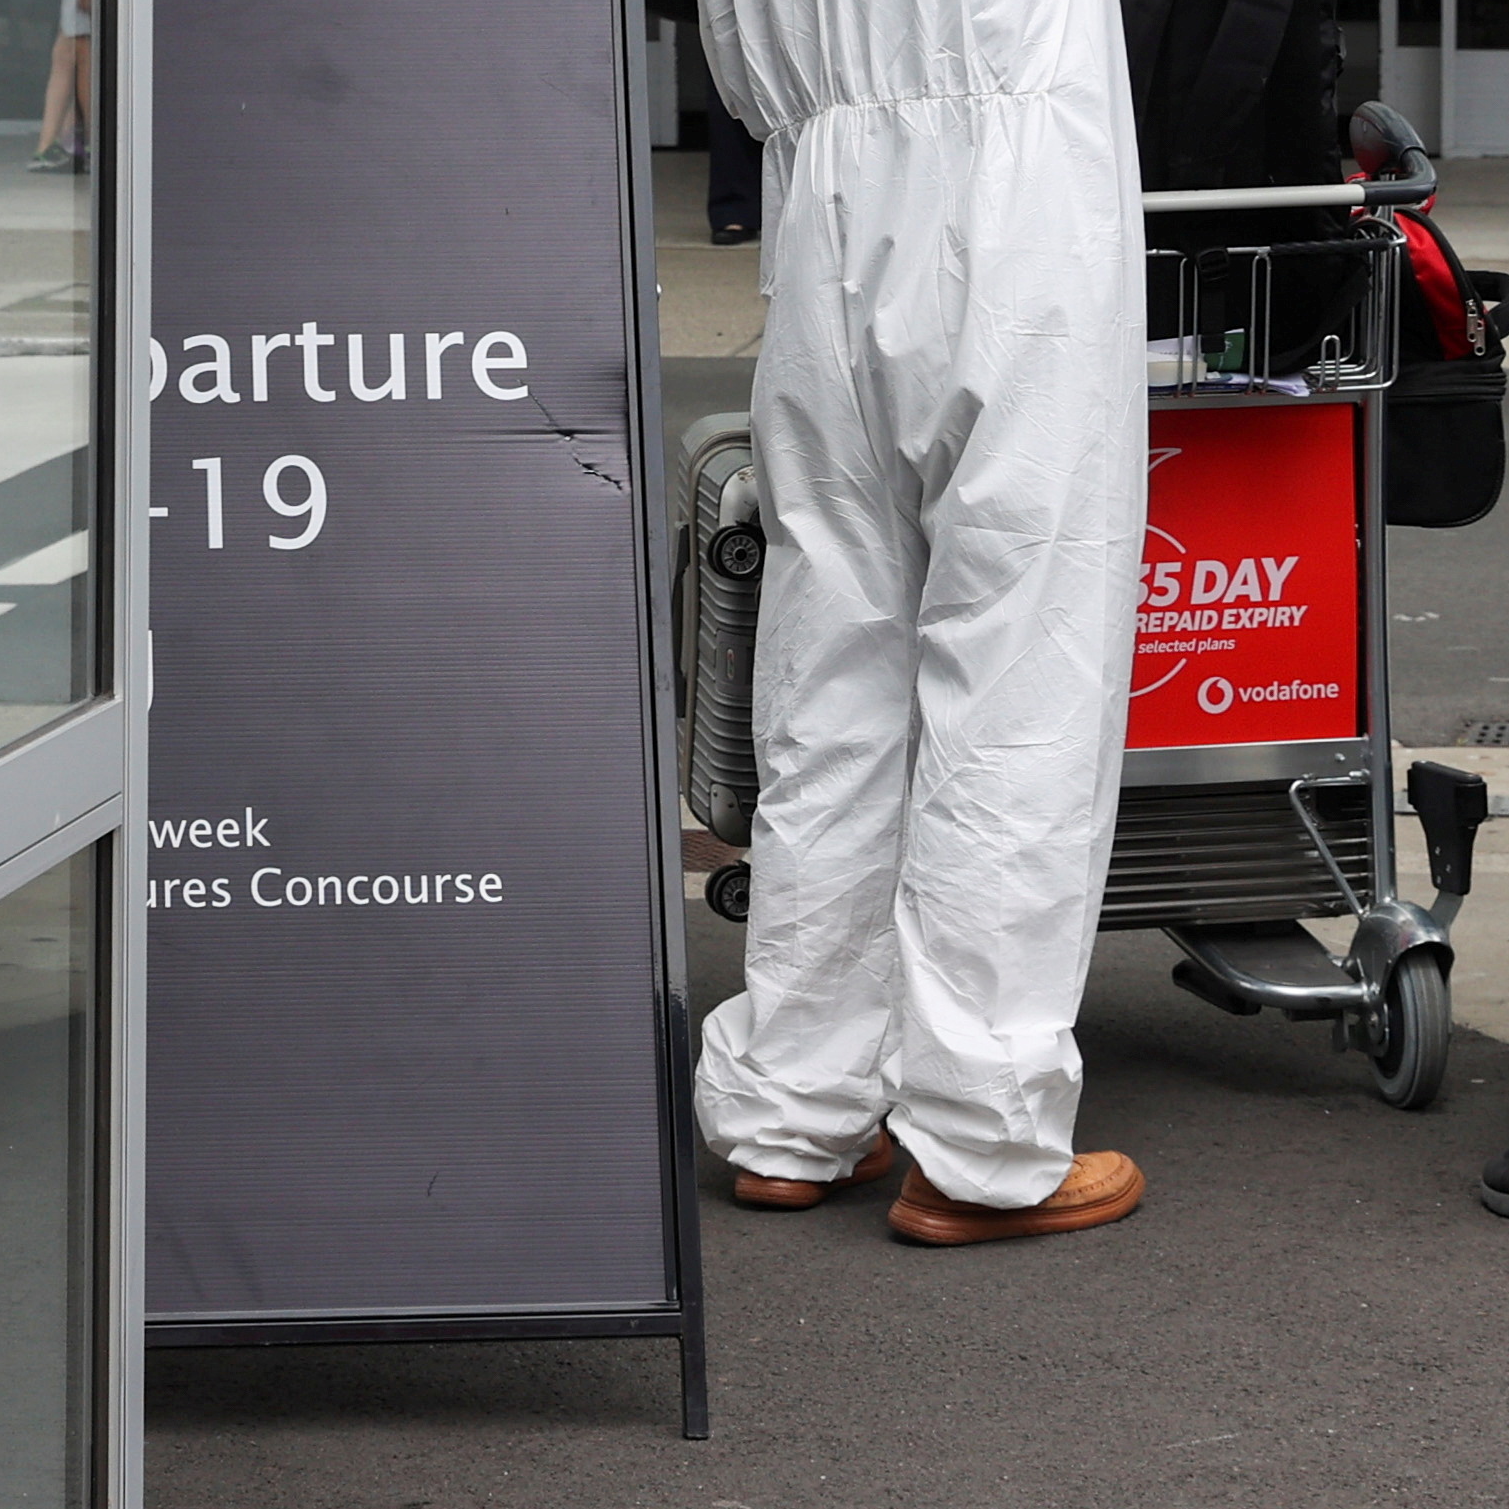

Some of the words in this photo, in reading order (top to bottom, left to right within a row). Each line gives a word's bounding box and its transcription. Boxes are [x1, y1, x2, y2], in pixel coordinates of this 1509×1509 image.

[1190, 555, 1300, 605] DAY
[1222, 605, 1309, 630] EXPIRY
[1137, 639, 1196, 654] selected
[1197, 637, 1236, 655] plans
[1239, 679, 1340, 703] vodafone
[148, 807, 271, 849] week
[249, 867, 504, 906] Concourse
